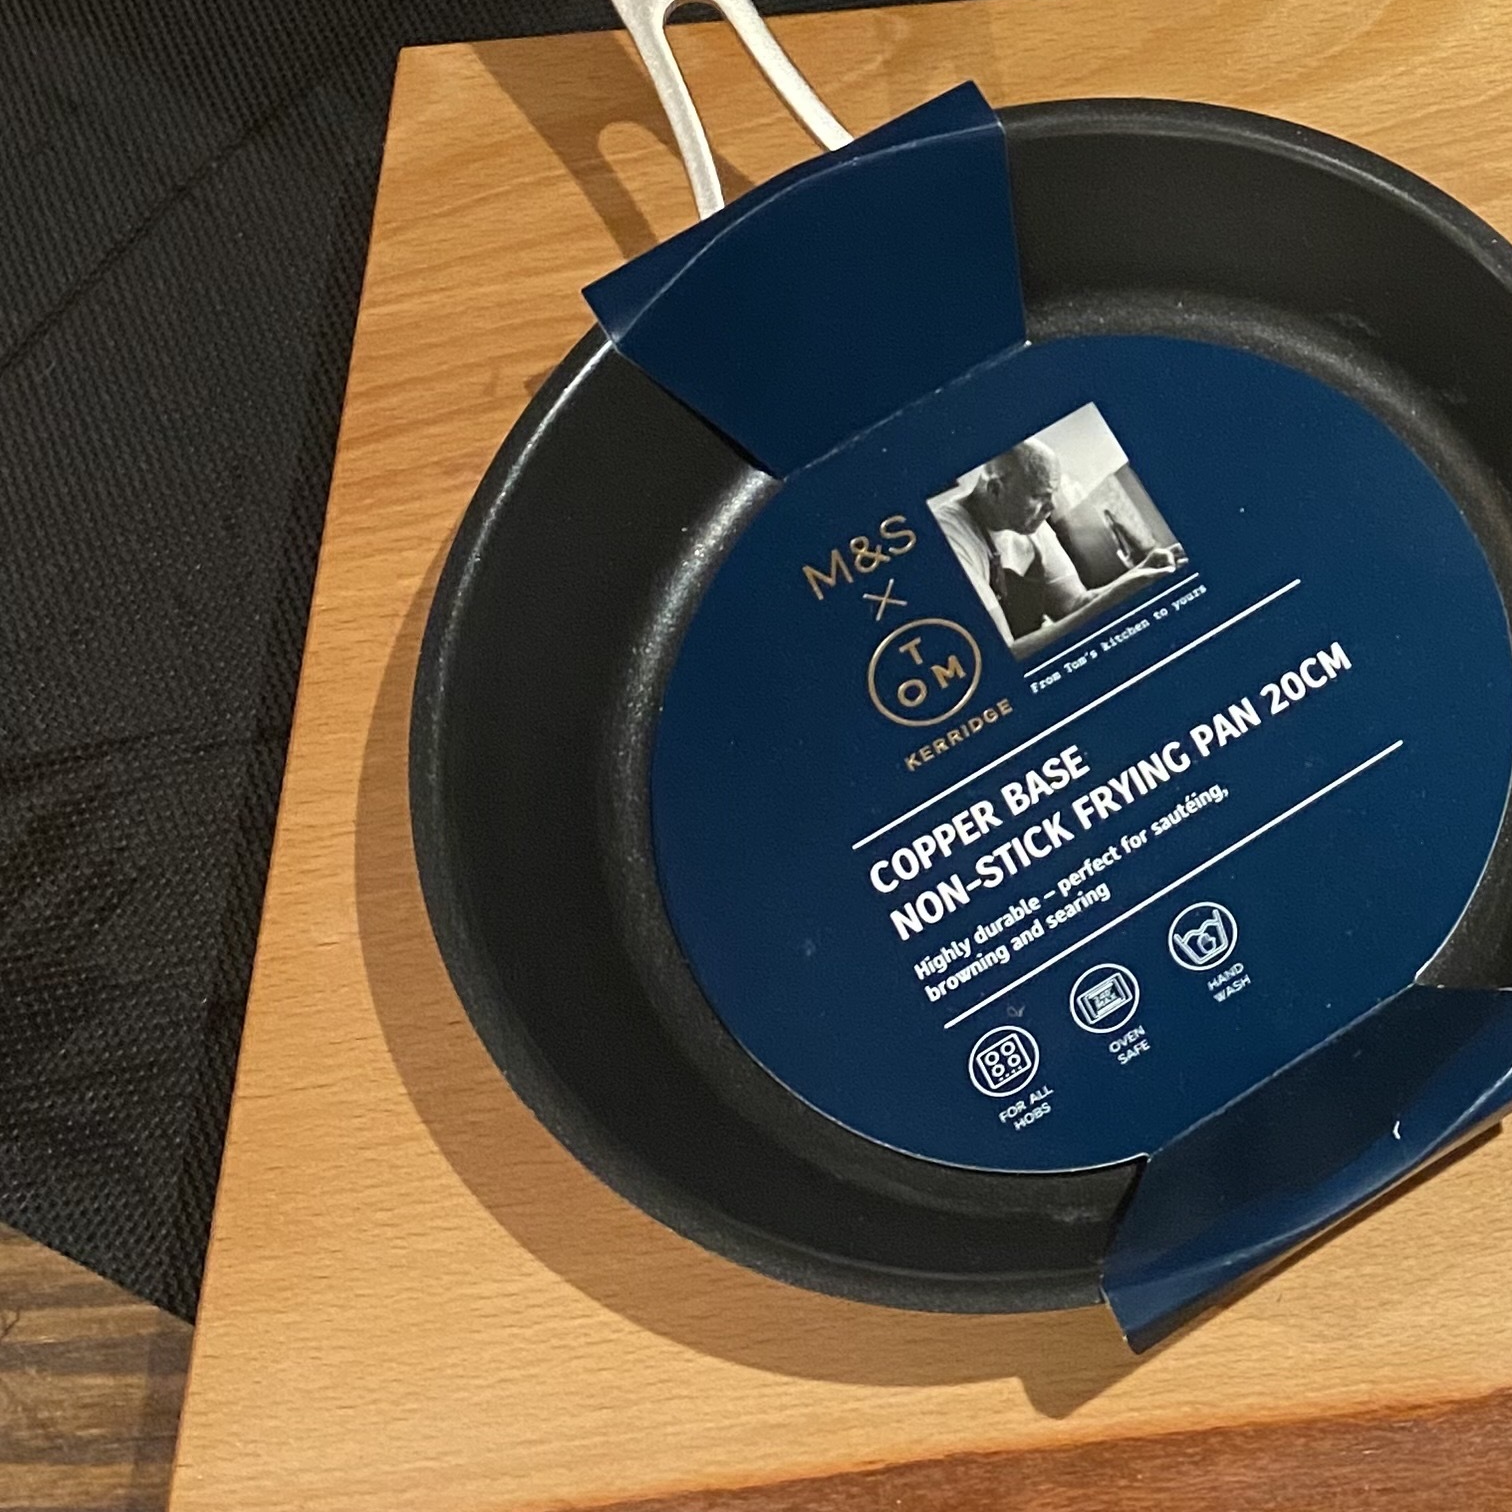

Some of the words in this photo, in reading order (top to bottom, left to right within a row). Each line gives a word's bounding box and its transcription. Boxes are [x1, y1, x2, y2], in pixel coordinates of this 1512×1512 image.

[803, 515, 916, 600] M&S
[897, 637, 966, 707] TOM
[1030, 673, 1062, 694] From
[1065, 648, 1097, 672] Tom's
[1101, 619, 1150, 651] kitchen
[1154, 606, 1168, 620] to
[1172, 584, 1206, 611] yours
[904, 699, 1014, 772] KERRIDGE
[869, 801, 1002, 894] COPPER
[1000, 746, 1090, 815] BASE
[889, 813, 1074, 941] NON-STICK
[1072, 742, 1190, 830] FRYING
[1189, 697, 1261, 757] PAN
[1259, 642, 1352, 716] 20CM
[914, 934, 972, 980] Highly
[974, 894, 1040, 945] durable
[1057, 847, 1121, 898] perfect
[1121, 831, 1148, 854] for
[1150, 780, 1229, 834] sautéing,
[924, 945, 1010, 1002] browning
[1012, 921, 1044, 950] and
[1047, 882, 1111, 929] searing
[1207, 963, 1244, 991] HAND
[1213, 974, 1251, 1003] WASH
[1109, 1025, 1146, 1054] OVEN
[1117, 1039, 1150, 1065] SAFE
[999, 1100, 1027, 1124] FOR
[1029, 1085, 1054, 1106] ALL
[1013, 1103, 1051, 1131] HOBS
